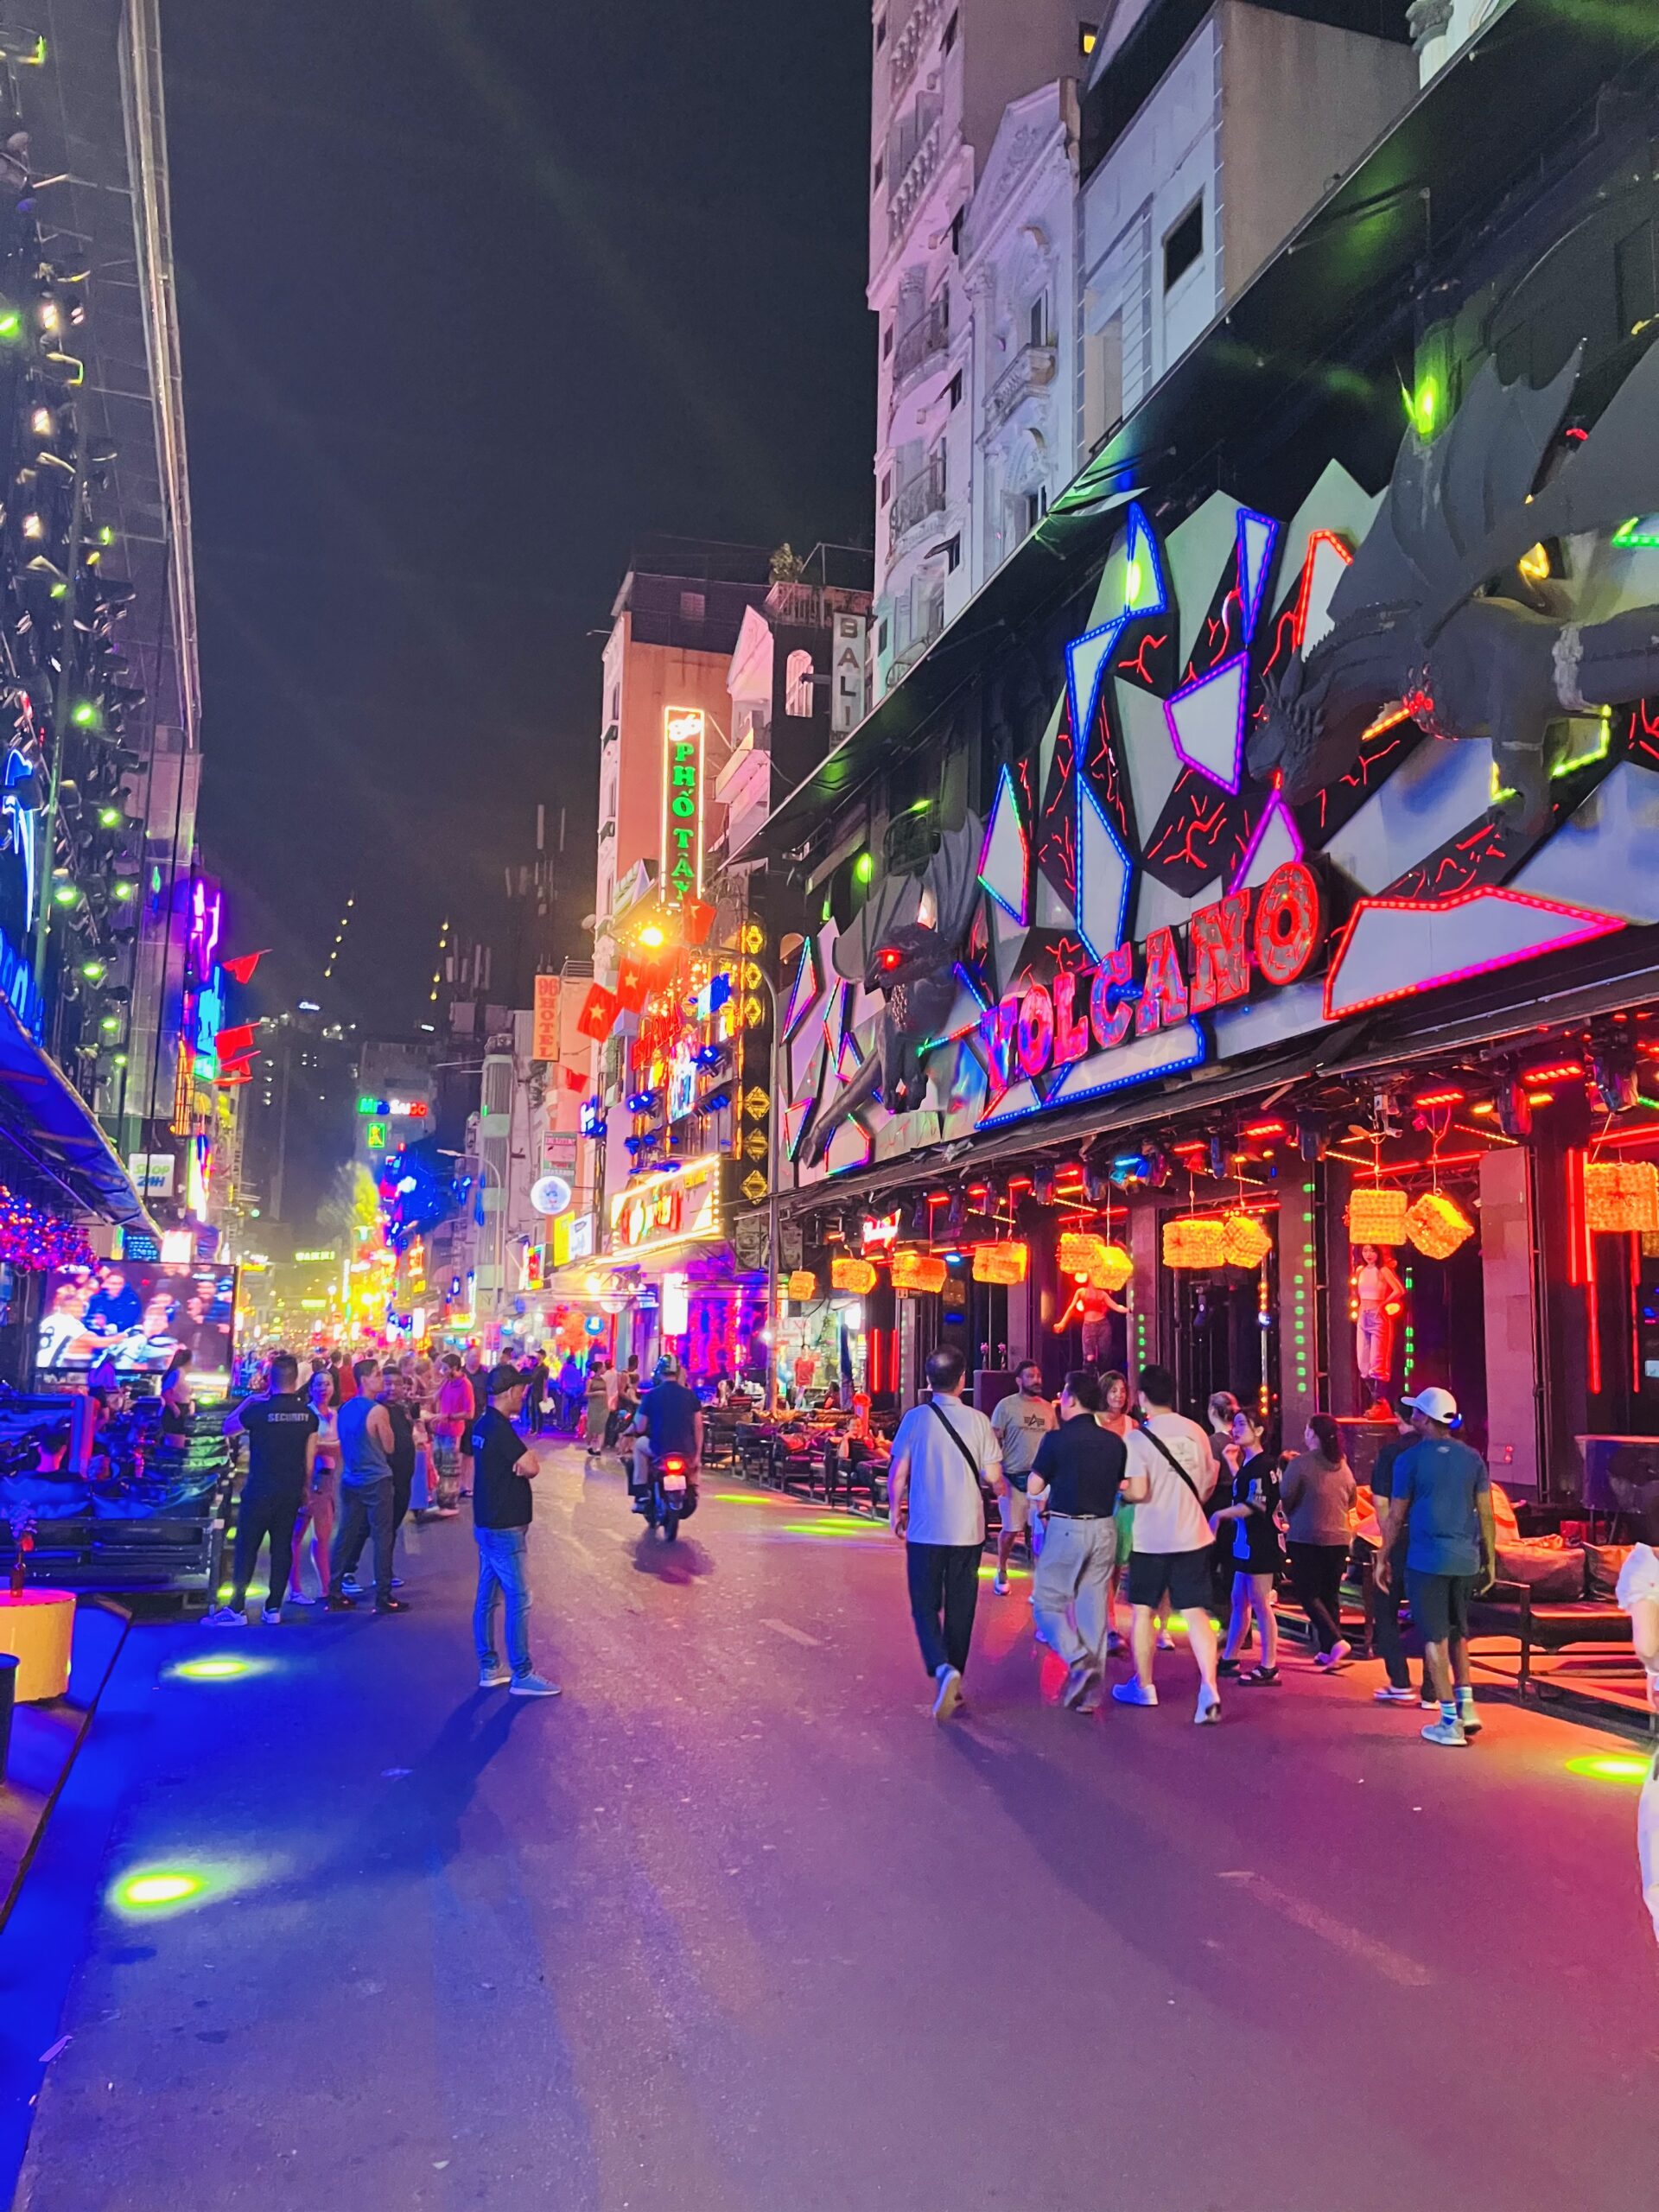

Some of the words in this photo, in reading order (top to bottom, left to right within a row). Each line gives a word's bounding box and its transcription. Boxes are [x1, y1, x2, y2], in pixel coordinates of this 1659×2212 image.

[837, 617, 860, 727] BALI
[671, 741, 696, 817] PHỐ
[537, 978, 559, 996] 96
[980, 861, 1319, 1091] VOLCANO
[538, 997, 556, 1058] HOTEL
[267, 1412, 309, 1422] SECURITY
